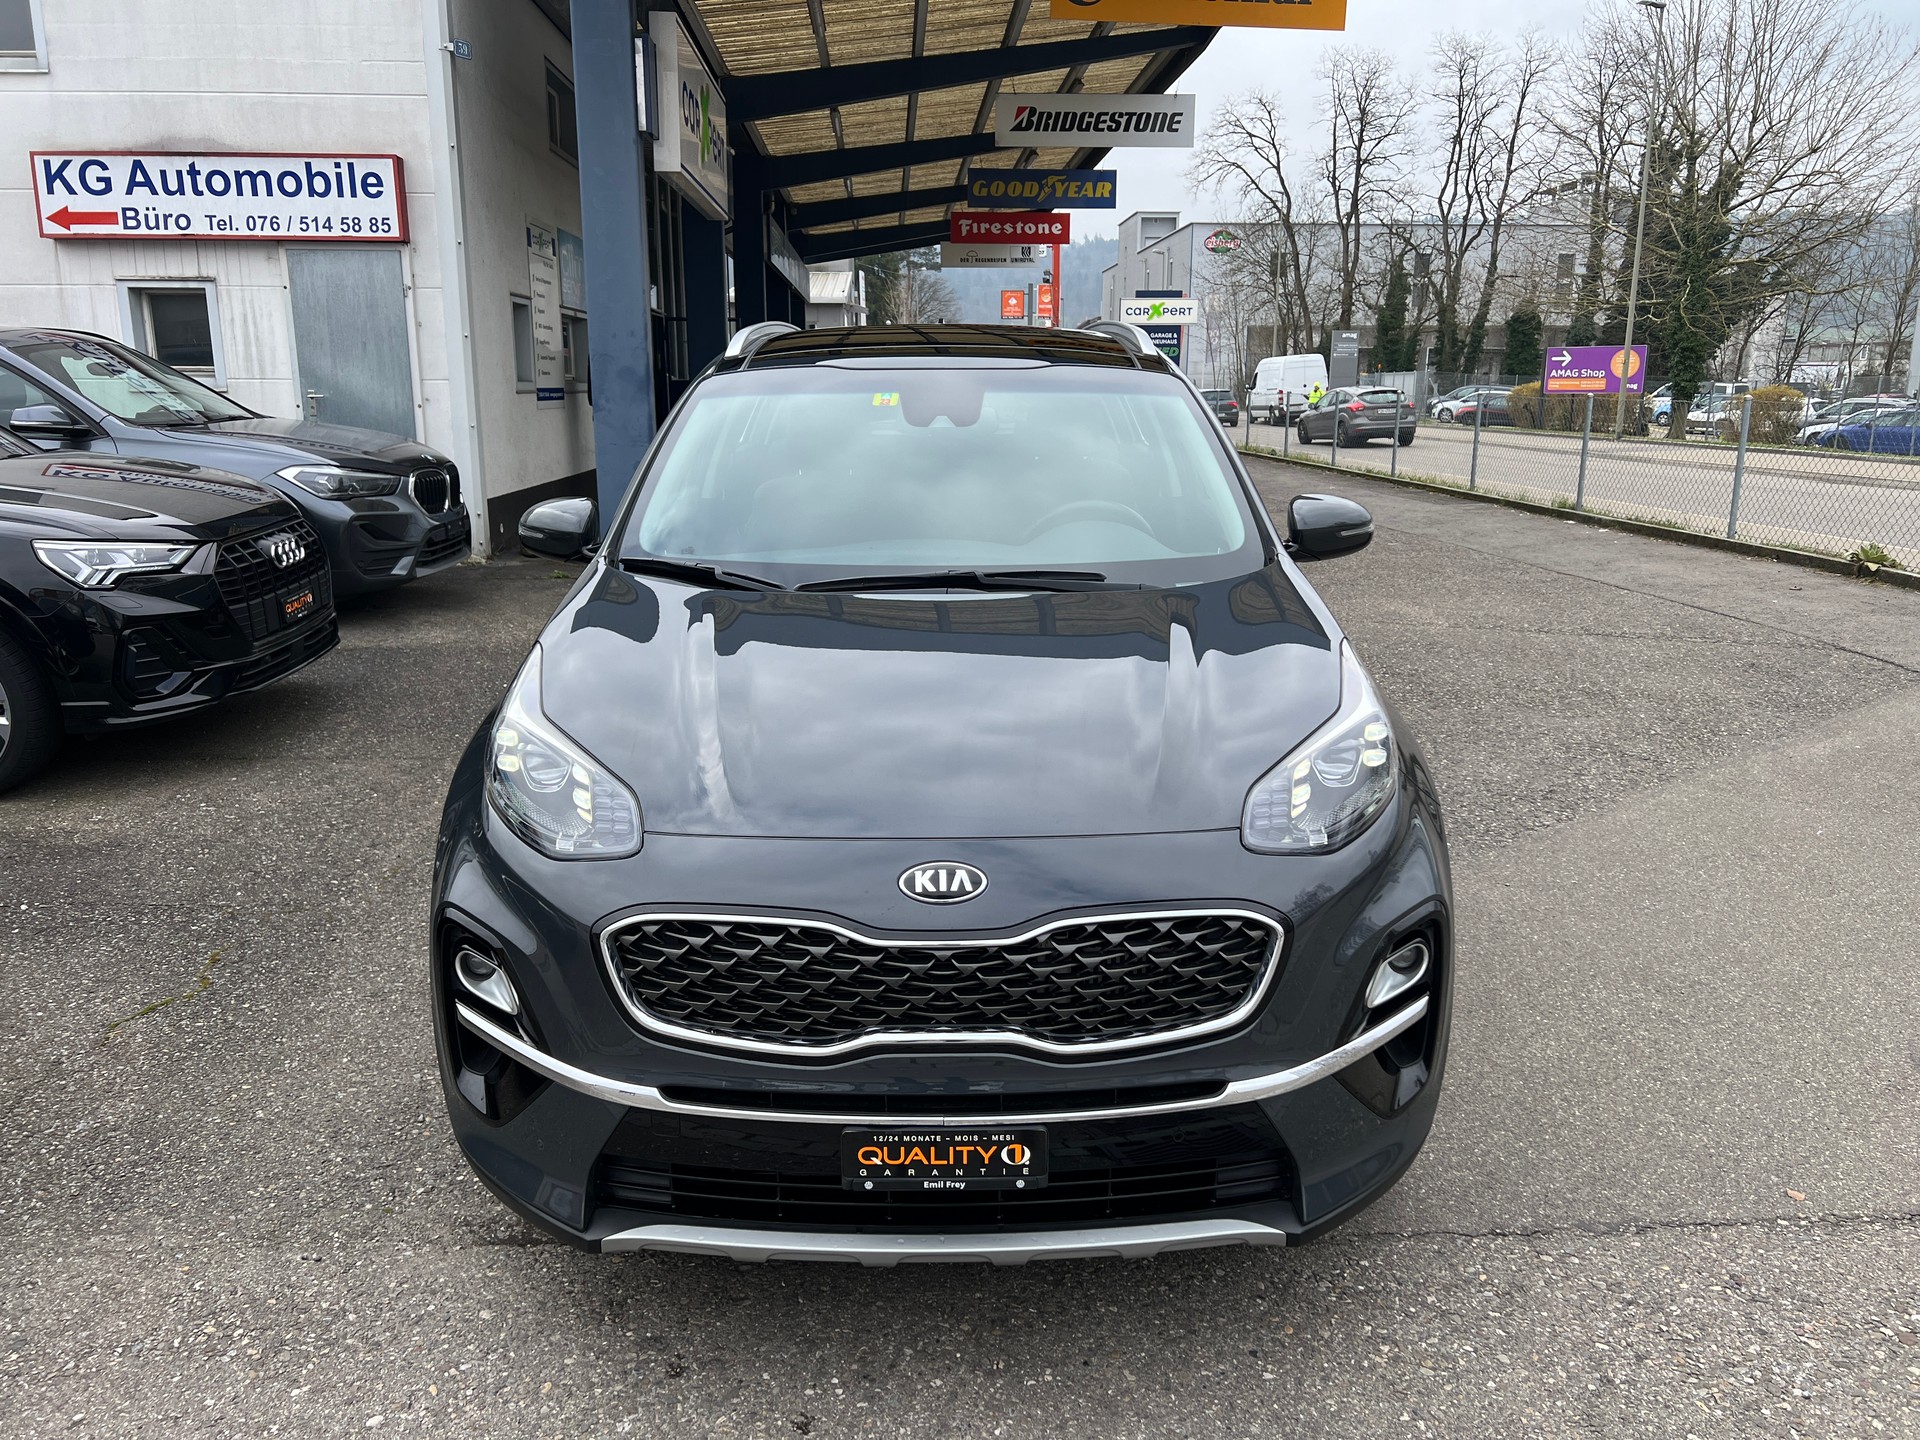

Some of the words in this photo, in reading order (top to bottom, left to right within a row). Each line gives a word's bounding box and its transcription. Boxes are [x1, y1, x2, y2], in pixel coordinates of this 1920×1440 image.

[1009, 105, 1184, 133] BRIDGESTONE
[42, 158, 113, 196] KG
[125, 158, 384, 199] Automobile
[121, 206, 192, 231] Büro
[205, 214, 239, 232] Tel.
[245, 215, 281, 233] 076
[286, 215, 293, 233] /
[299, 215, 333, 233] 514
[339, 216, 362, 233] 58
[368, 216, 392, 234] 85
[958, 219, 1063, 237] Firestone
[1550, 369, 1579, 377] AMAG
[1580, 369, 1606, 379] Shop
[914, 869, 973, 893] KIA
[857, 1146, 998, 1165] QUALITY
[859, 1168, 1030, 1176] GARANTIE
[923, 1181, 944, 1189] Emil
[946, 1181, 966, 1190] Frey
